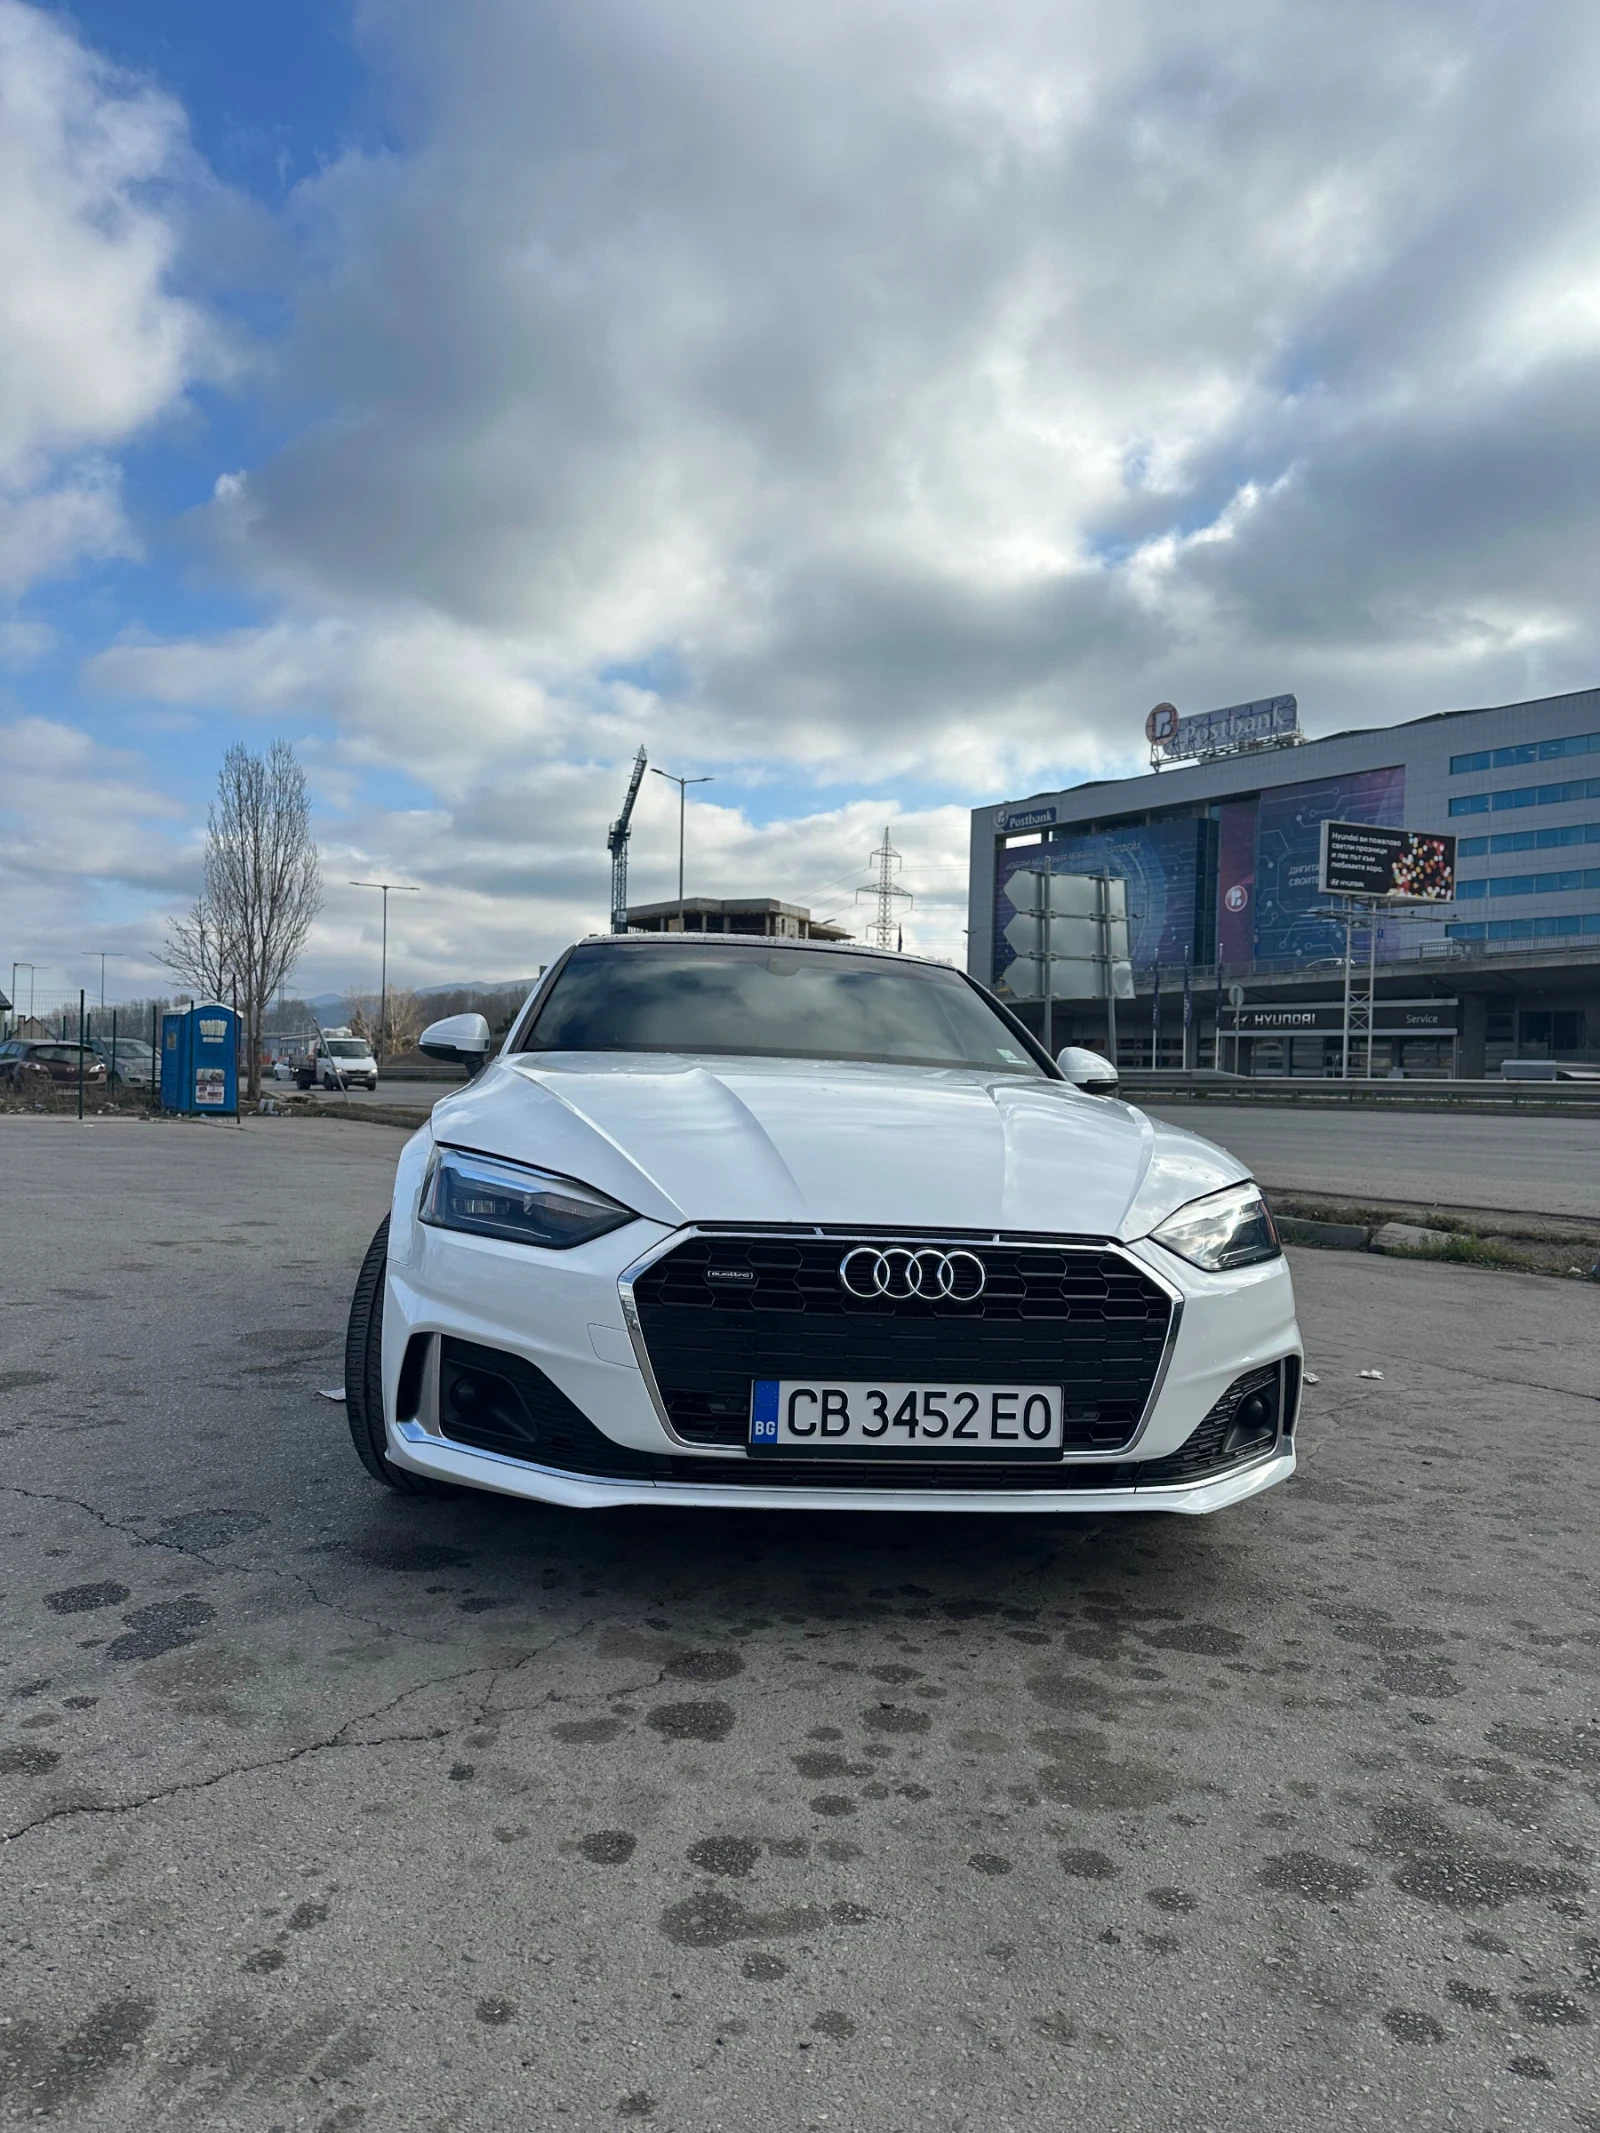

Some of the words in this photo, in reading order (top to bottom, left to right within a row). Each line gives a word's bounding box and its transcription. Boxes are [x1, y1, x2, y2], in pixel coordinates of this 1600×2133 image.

[1184, 706, 1285, 743] Postbank
[1009, 810, 1053, 828] Postbank
[1332, 832, 1359, 841] Hyundai
[1356, 845, 1388, 855] празници
[1288, 864, 1320, 876] ДИГИТА
[1331, 861, 1366, 870] любимите
[1254, 1013, 1315, 1025] HYUNDAI
[1406, 1014, 1438, 1024] Service
[788, 1388, 850, 1437] CB
[862, 1389, 979, 1439] 3452
[755, 1421, 776, 1435] BG
